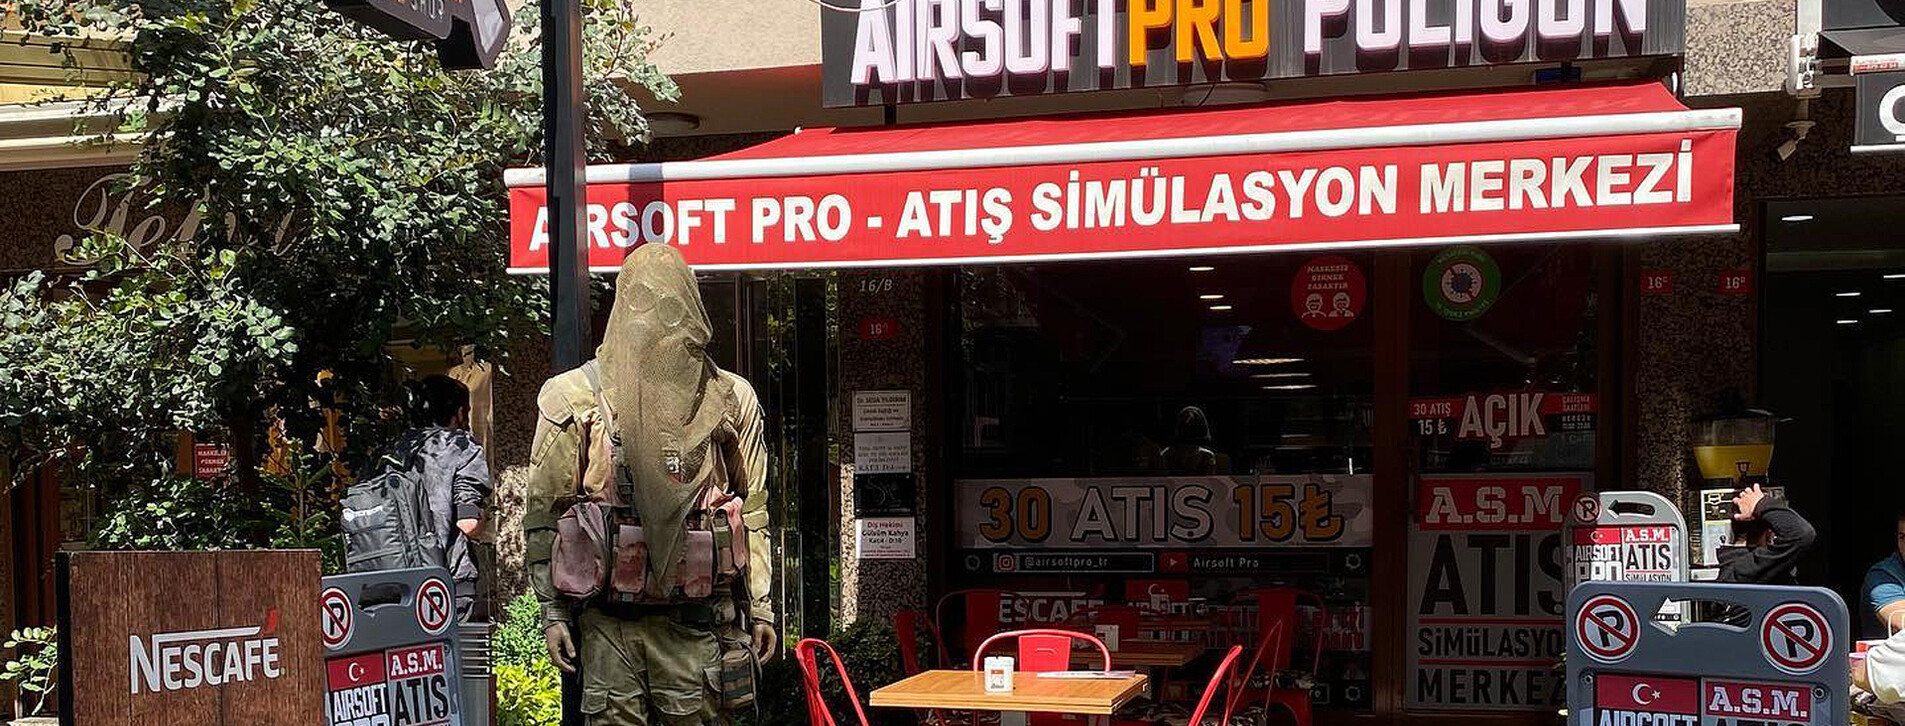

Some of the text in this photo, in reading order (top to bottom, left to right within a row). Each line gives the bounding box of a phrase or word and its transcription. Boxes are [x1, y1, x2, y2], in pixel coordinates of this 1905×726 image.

[529, 139, 1693, 250] ARSOFT PRO - ATIŞ SİMÜLASYON MERKEZİ
[1414, 403, 1427, 416] 30
[1458, 393, 1546, 449] AÇIK
[1418, 419, 1434, 435] 15
[979, 486, 1052, 542] 30
[1575, 544, 1622, 562] AIRSOFT
[390, 649, 443, 676] A.S.M.
[333, 682, 387, 723] AIRSOFT
[1708, 685, 1808, 718] A.S.M.
